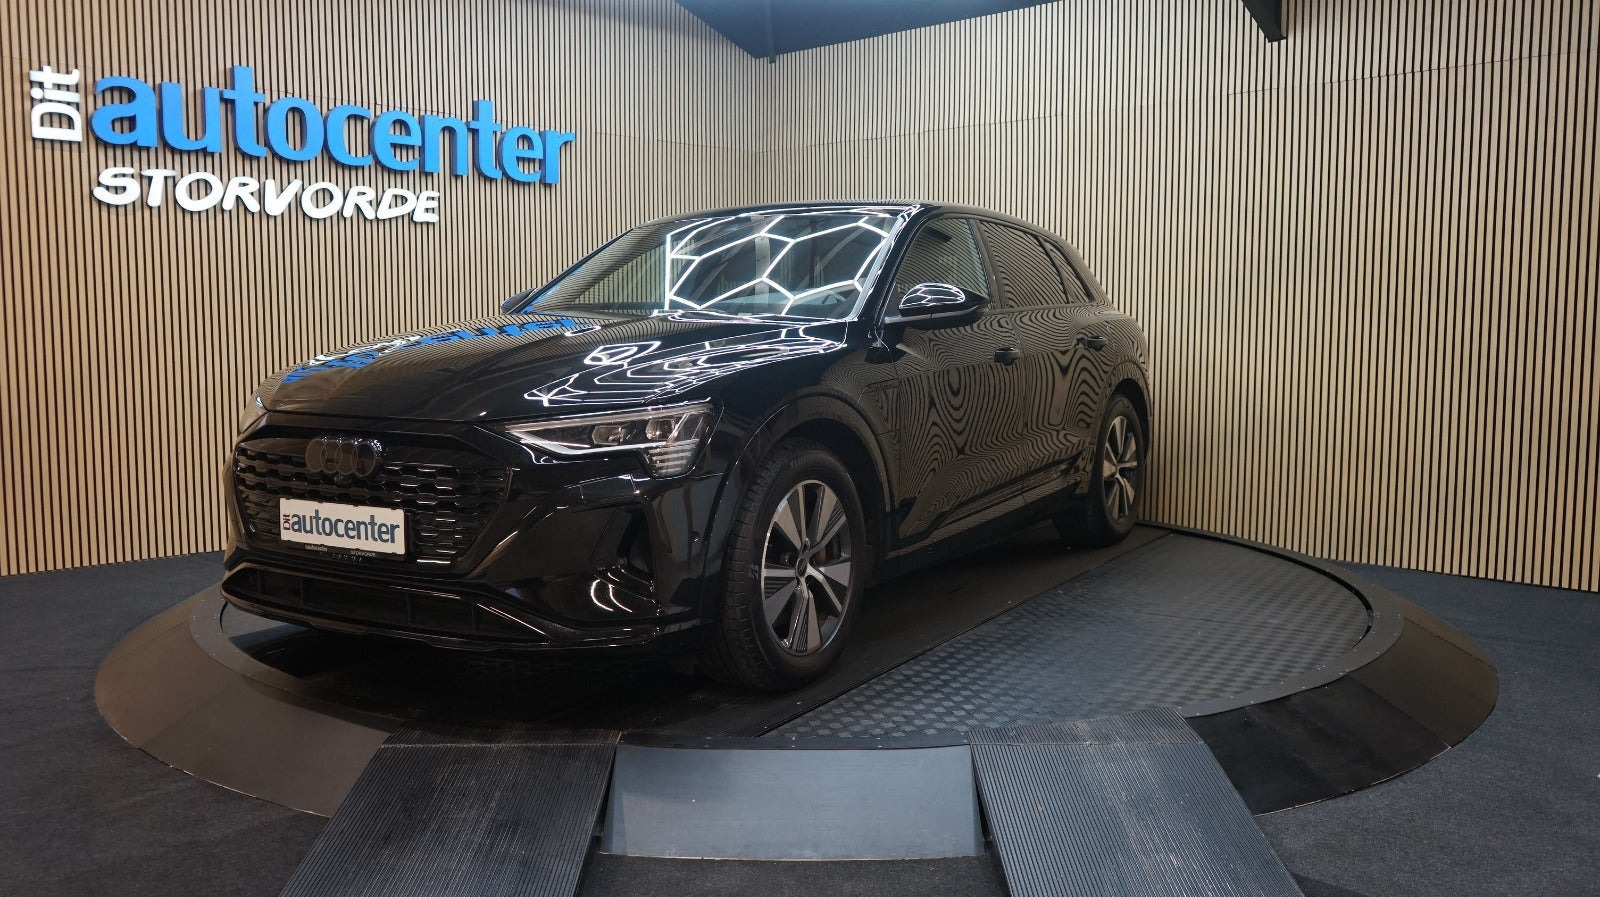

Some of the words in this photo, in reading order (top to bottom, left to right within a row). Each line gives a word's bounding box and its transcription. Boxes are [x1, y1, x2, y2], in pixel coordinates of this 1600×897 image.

[29, 65, 83, 143] Dit
[90, 65, 576, 185] autocenter
[92, 165, 442, 224] STORVORDE
[282, 513, 291, 531] Dit
[291, 509, 400, 543] autocenter
